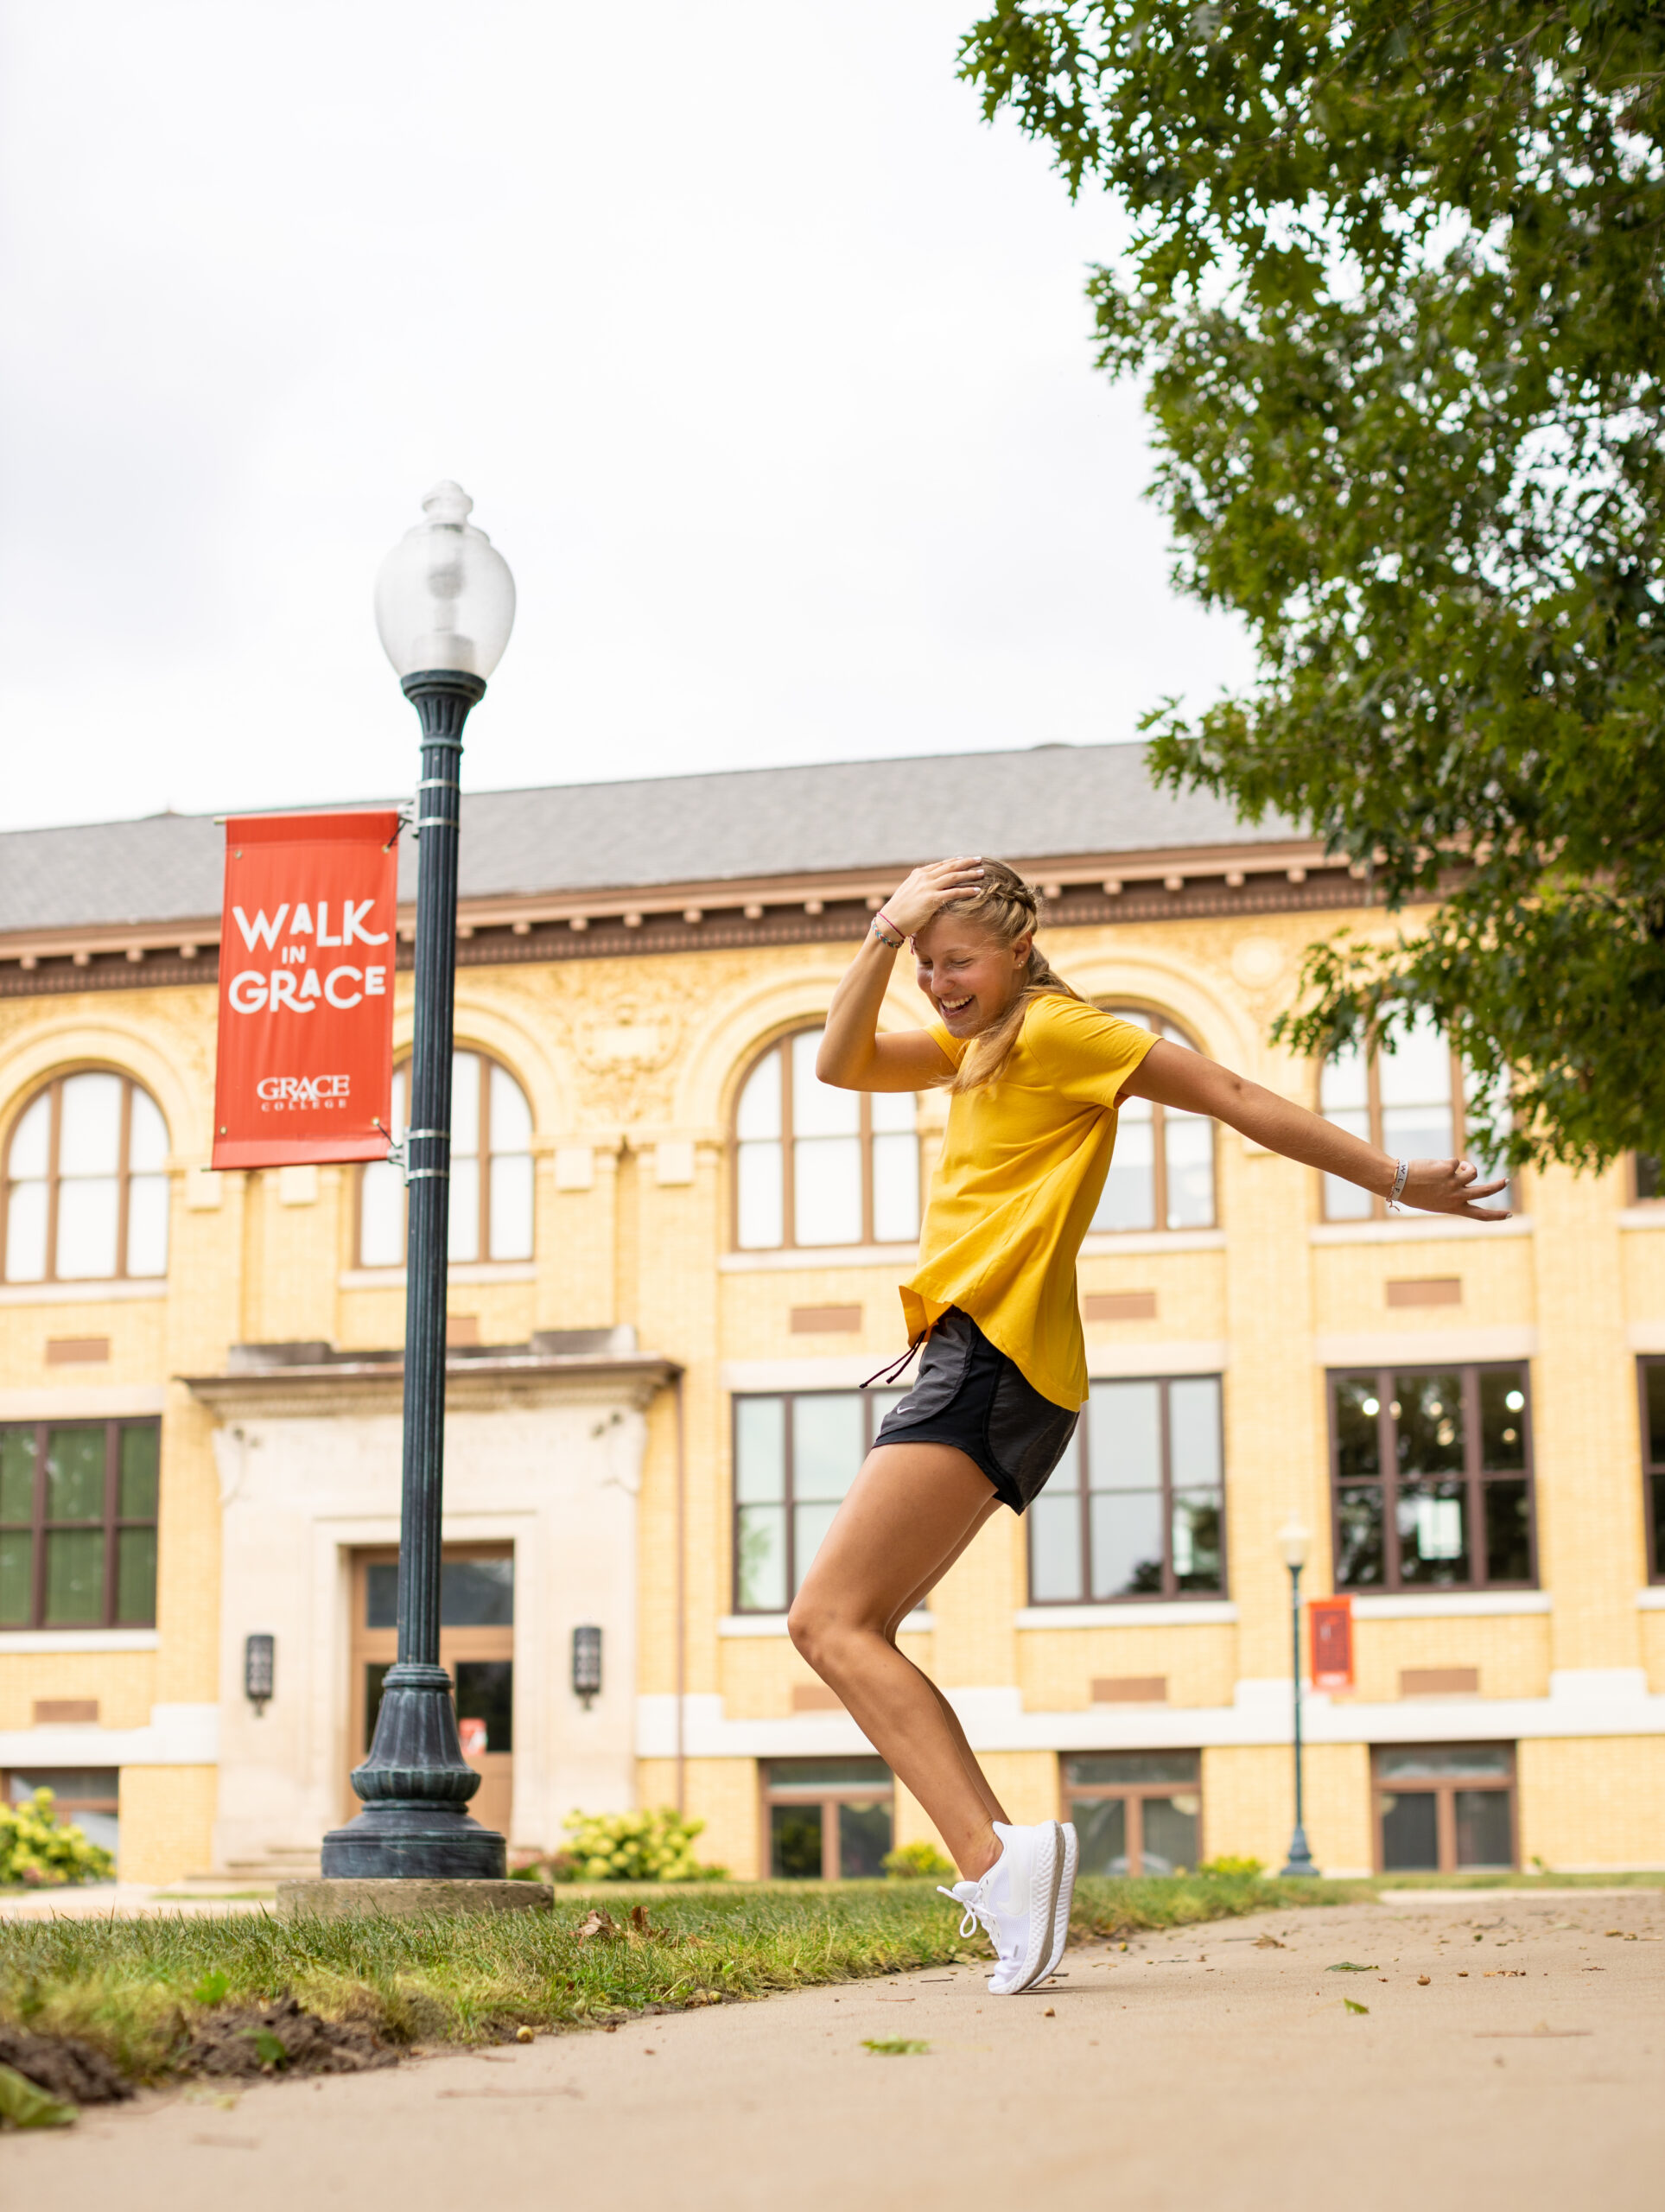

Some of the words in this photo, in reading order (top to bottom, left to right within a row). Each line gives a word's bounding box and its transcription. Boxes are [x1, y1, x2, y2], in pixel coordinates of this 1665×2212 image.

[232, 899, 389, 952] WALK
[282, 945, 306, 964] IN
[228, 965, 386, 1014] GRACE
[257, 1075, 350, 1101] GRACE
[261, 1099, 347, 1112] COLLEGE
